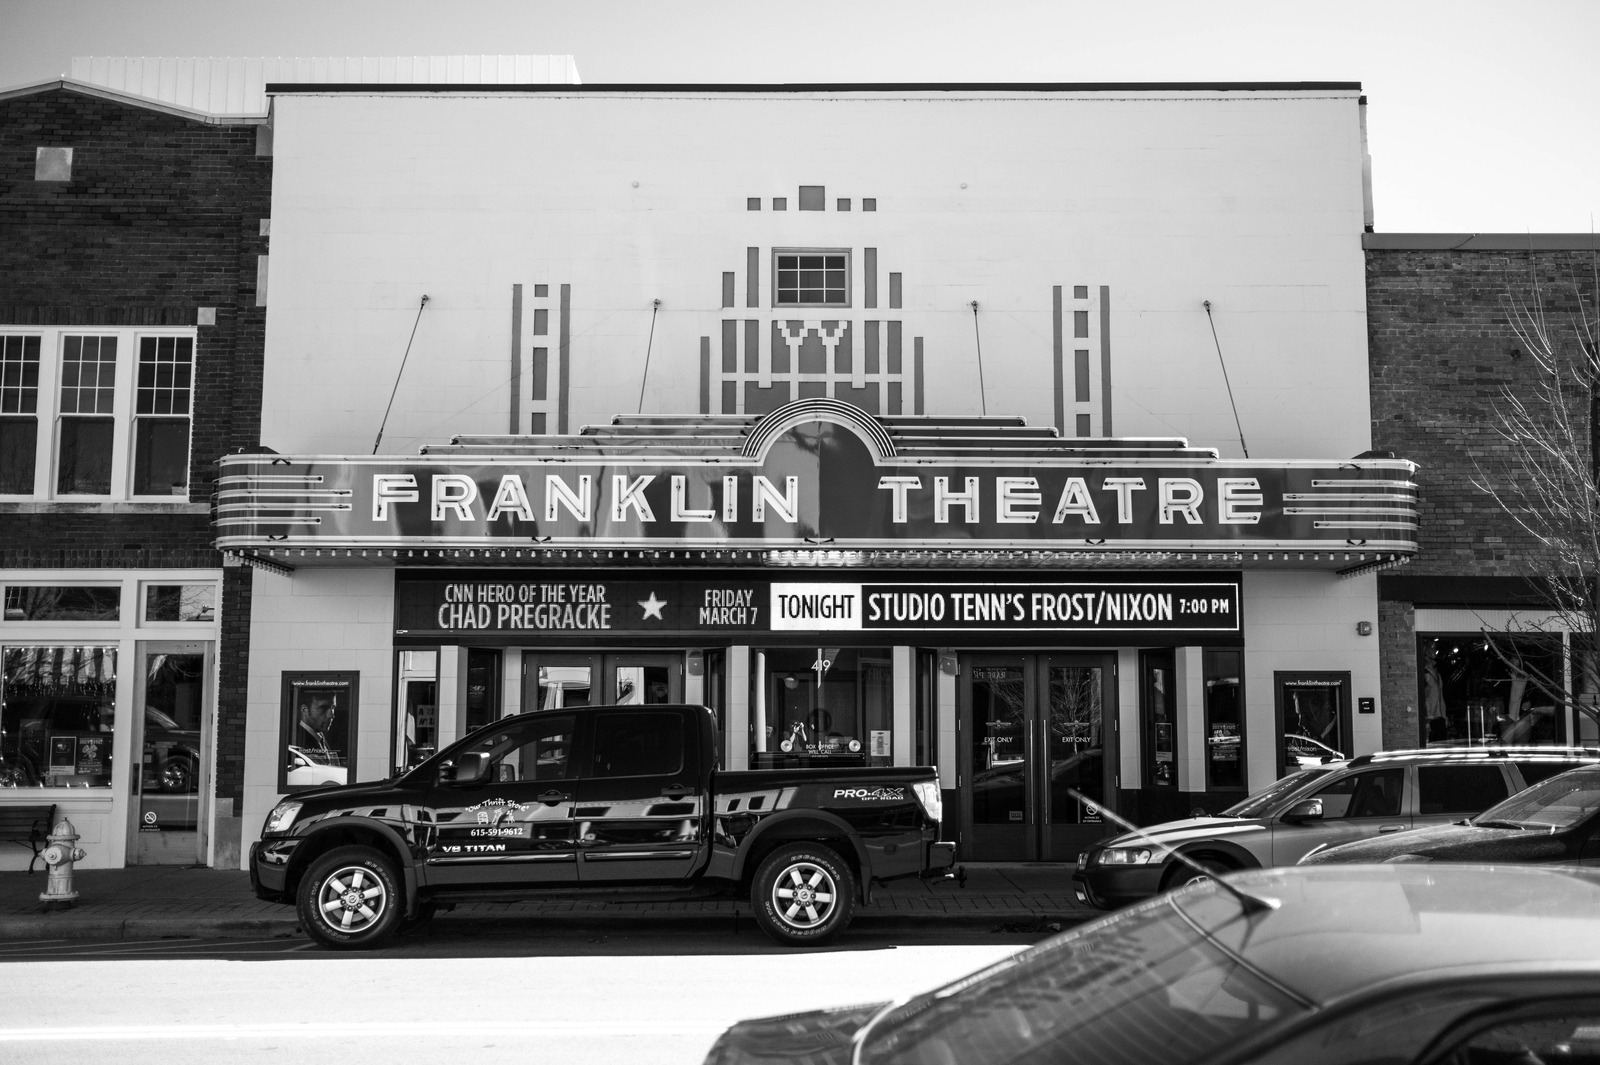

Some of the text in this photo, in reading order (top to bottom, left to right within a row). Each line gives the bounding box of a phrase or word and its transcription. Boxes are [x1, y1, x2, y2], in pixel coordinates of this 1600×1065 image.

[372, 474, 1264, 524] FRANKLIN THEATRE
[445, 584, 606, 602] CNN HERO OF THE YEAR
[704, 589, 754, 607] FRIDAY
[438, 603, 612, 629] CHAD PREGRACKE
[699, 607, 758, 625] MARCH 7
[778, 590, 1229, 625] TONIGHT STUDIO TENN'S FROST/NIXON 7:00 PM
[811, 659, 831, 671] 419
[482, 797, 506, 807] Thrift
[833, 787, 905, 799] PRO-4X
[470, 827, 523, 837] 615-591-9612
[464, 844, 506, 852] TITAN
